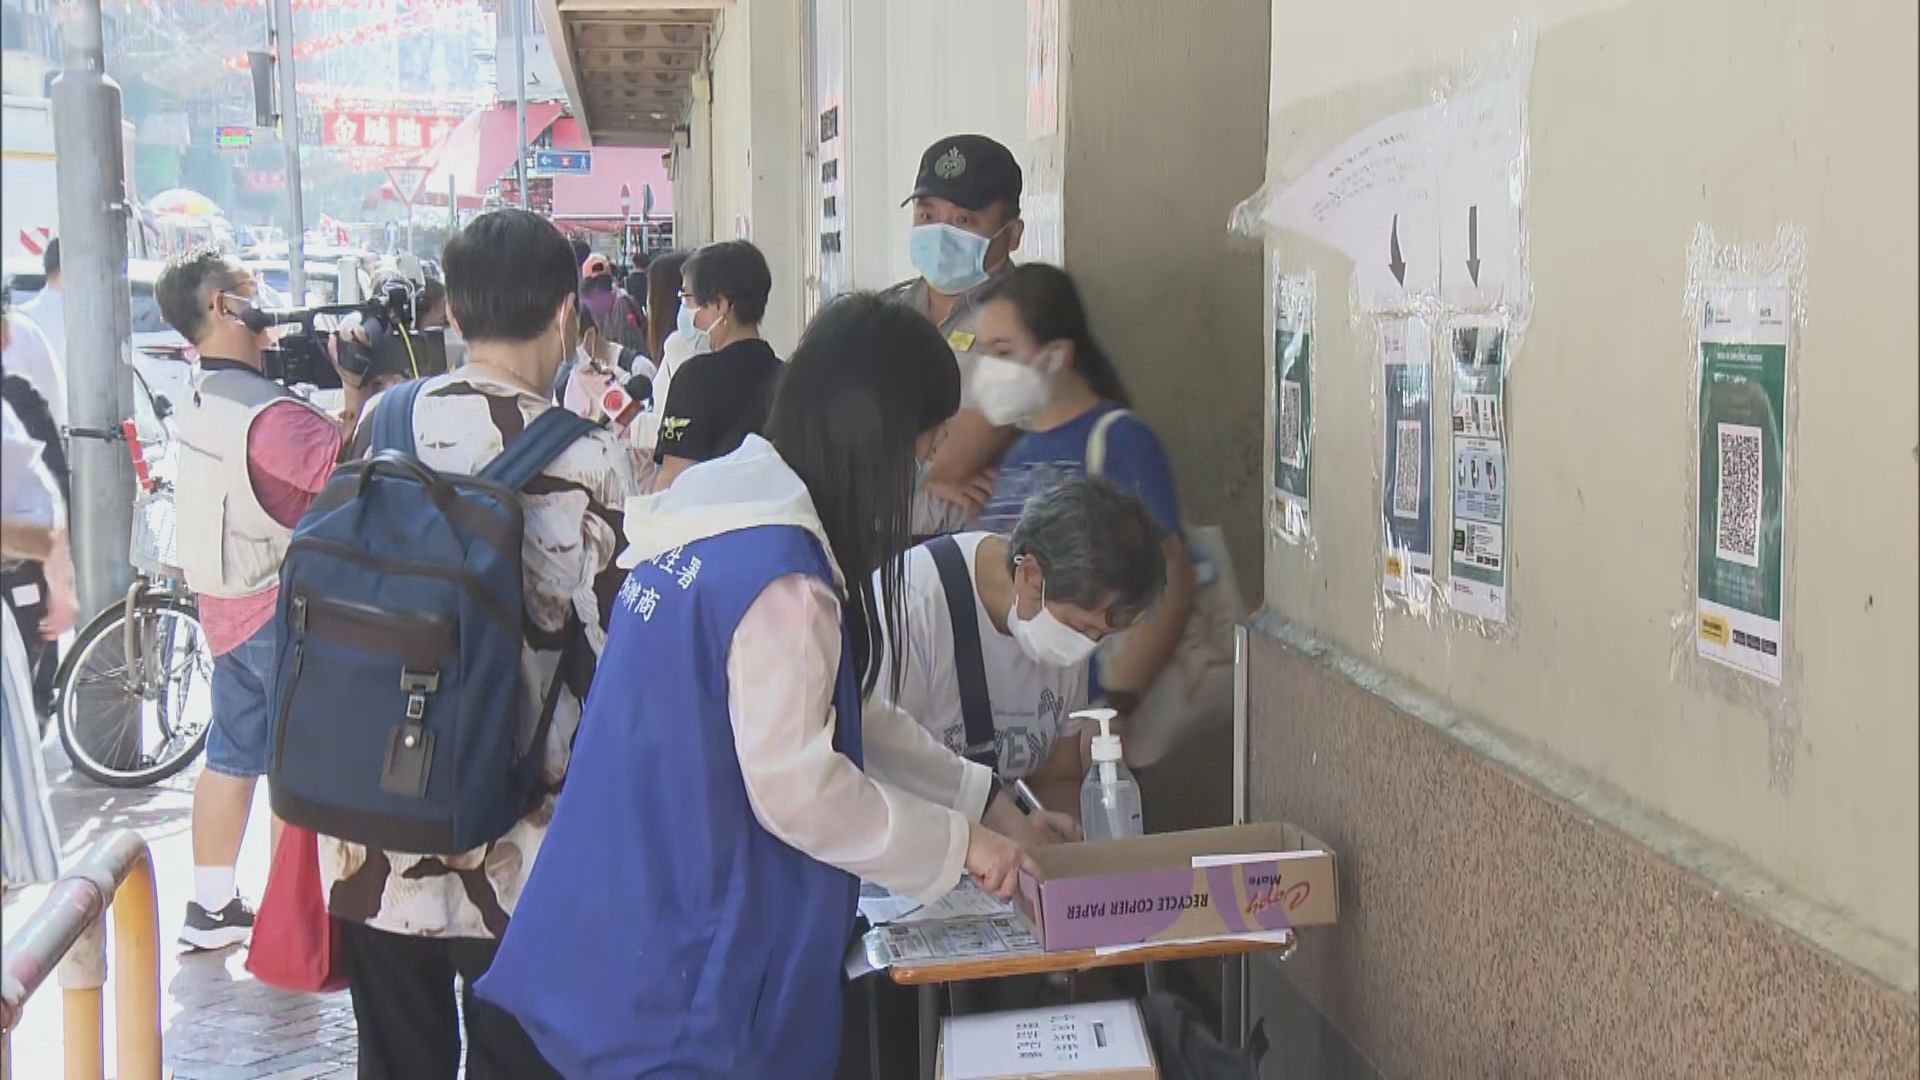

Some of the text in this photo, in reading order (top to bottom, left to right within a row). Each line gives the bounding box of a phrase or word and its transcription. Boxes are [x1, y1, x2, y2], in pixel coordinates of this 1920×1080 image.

[651, 545, 702, 590] 生署
[1248, 874, 1282, 886] Mate
[1066, 892, 1209, 920] RECYCLE COPIER PAPER
[1245, 880, 1311, 914] Copy
